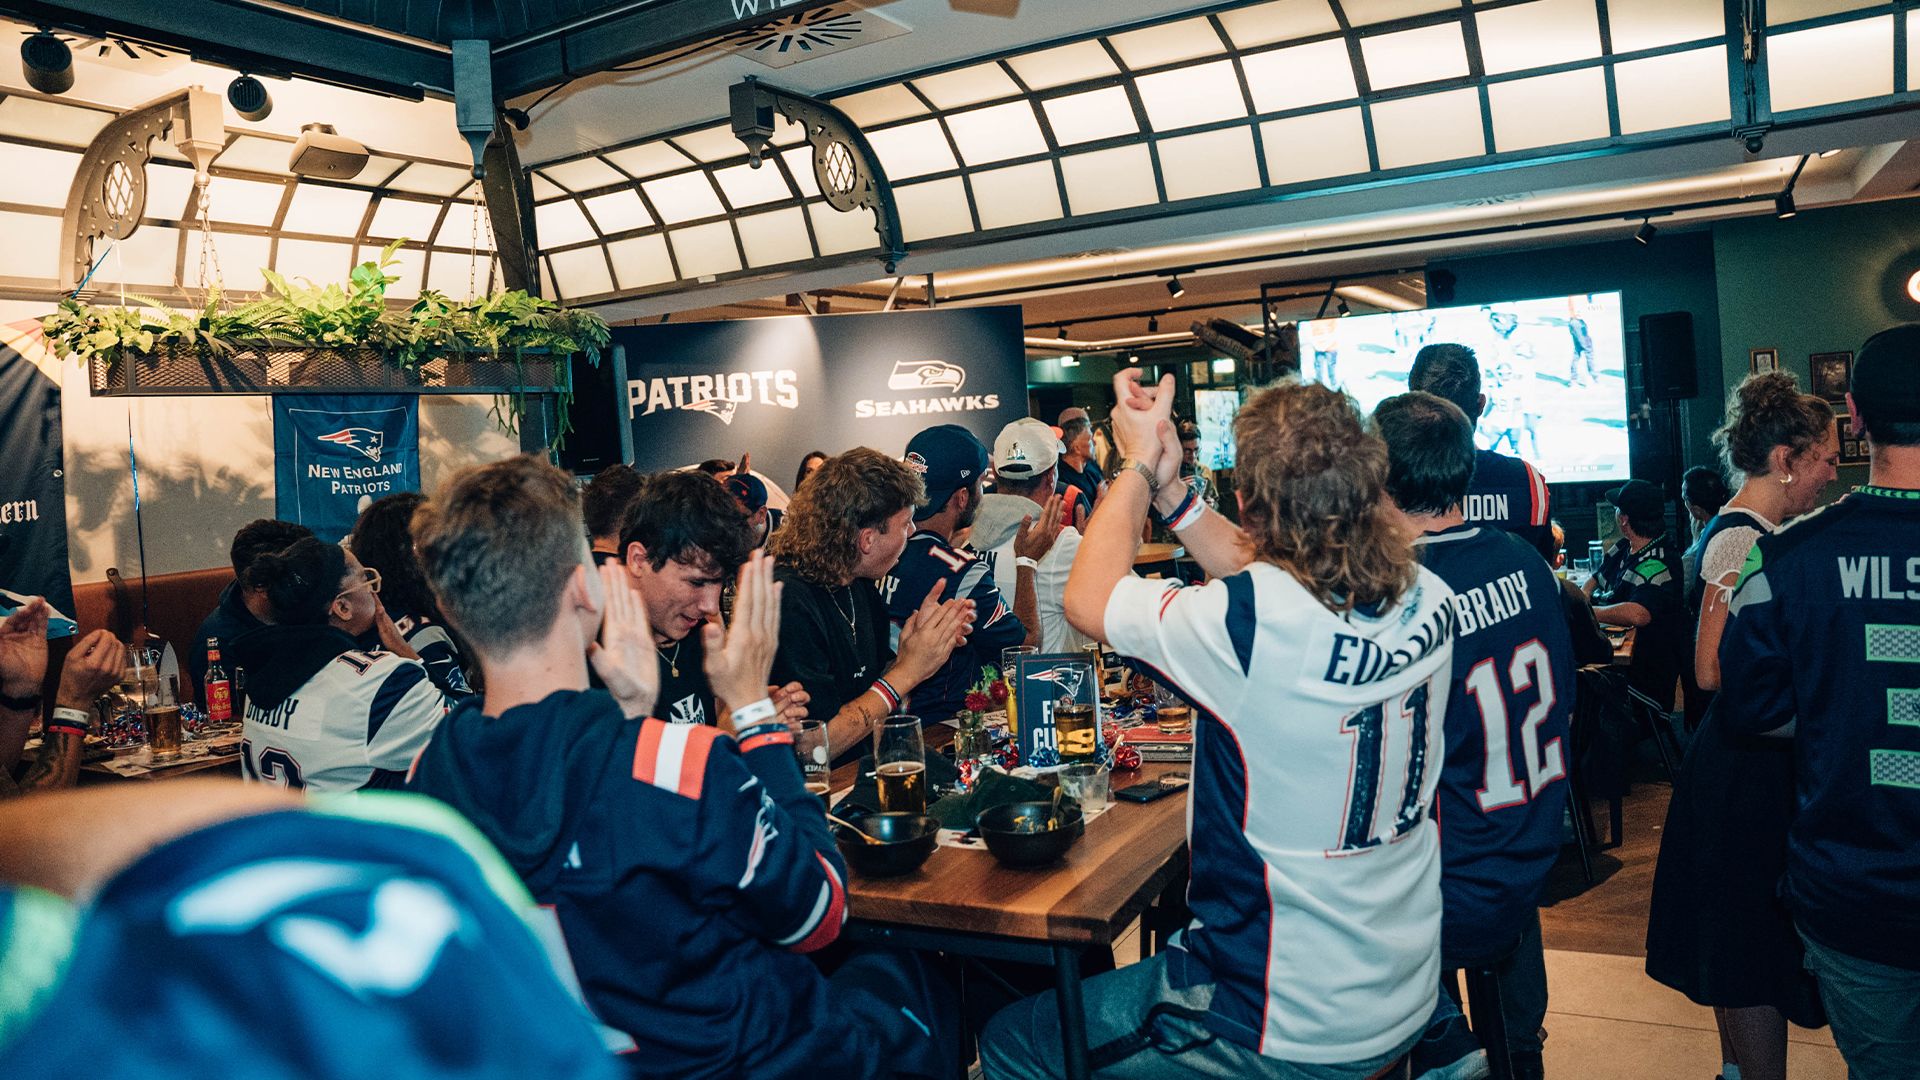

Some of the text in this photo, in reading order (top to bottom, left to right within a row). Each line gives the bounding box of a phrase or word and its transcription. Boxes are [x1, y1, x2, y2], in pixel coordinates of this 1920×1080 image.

[627, 369, 799, 419] PATRIOTS
[855, 394, 1000, 418] SEAHAWKS
[308, 463, 403, 479] NEW ENGLAND
[331, 481, 391, 494] PATRIOTS
[1453, 570, 1532, 637] BRADY
[1465, 637, 1567, 813] 12
[1324, 674, 1434, 859] 11
